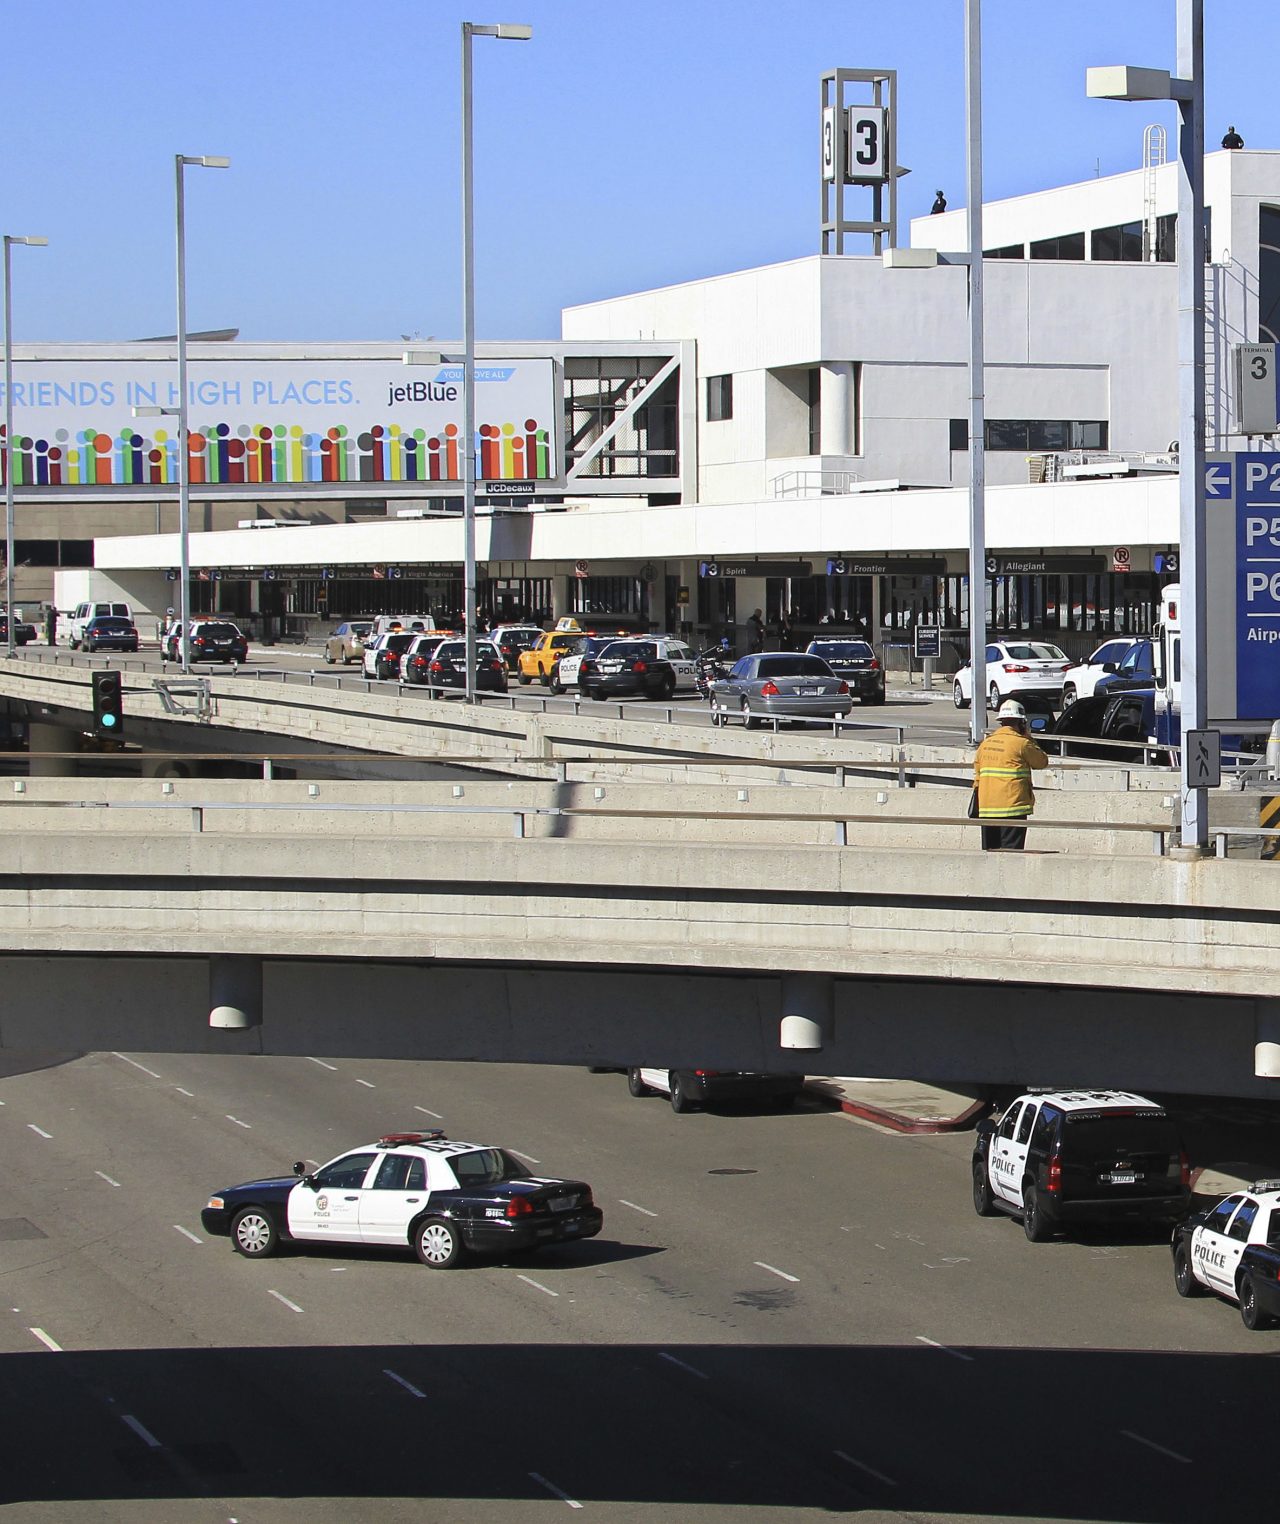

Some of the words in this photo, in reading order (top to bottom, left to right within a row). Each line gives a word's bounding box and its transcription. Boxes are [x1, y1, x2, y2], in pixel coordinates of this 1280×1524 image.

[825, 121, 832, 166] 3
[856, 119, 878, 166] 3
[492, 370, 505, 378] ALL
[1250, 355, 1268, 380] 3
[126, 381, 157, 405] IN
[252, 379, 361, 405] PLACES.
[388, 381, 458, 407] jetBlue
[487, 484, 534, 493] JCDecaux
[708, 563, 718, 576] 3
[726, 567, 746, 575] Spirit
[835, 560, 845, 574] 3
[854, 564, 886, 573] Frontier
[986, 558, 998, 573] 3
[1006, 562, 1046, 572] Allegiant
[1166, 554, 1178, 571] 3
[268, 570, 275, 580] 3
[327, 569, 335, 579] 3
[393, 569, 401, 578] 3
[561, 664, 578, 673] POLICE
[991, 1156, 1016, 1177] POLICE
[1194, 1244, 1226, 1269] POLICE
